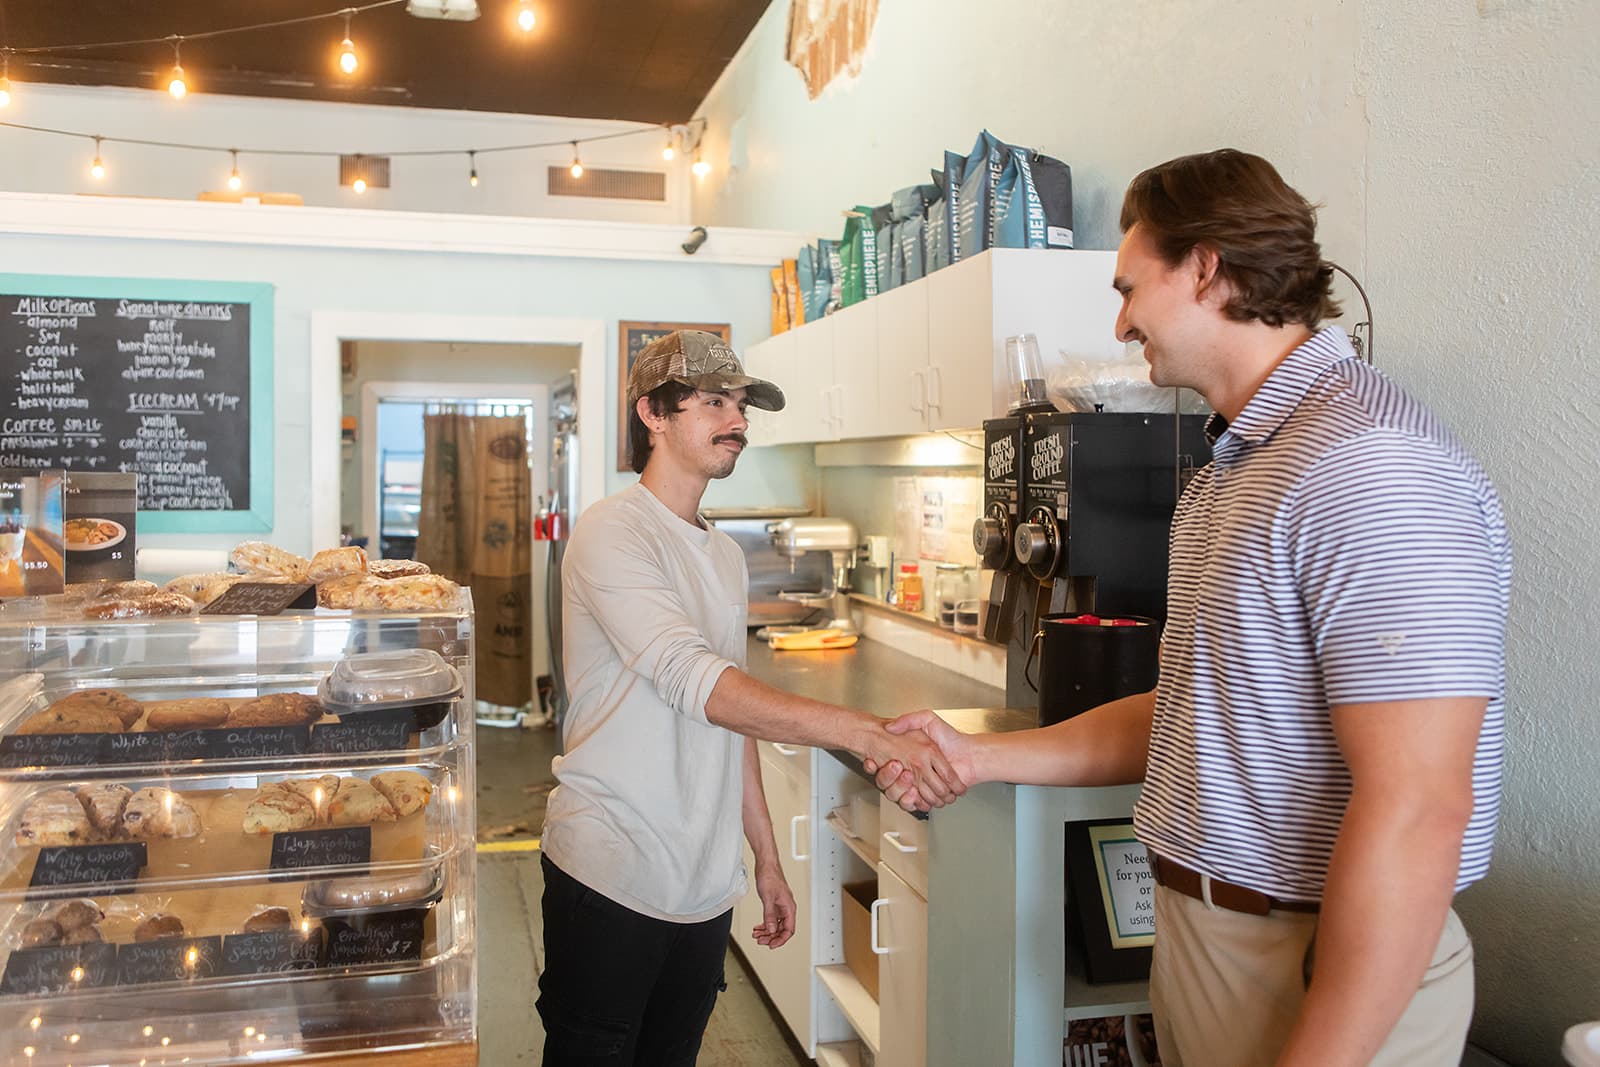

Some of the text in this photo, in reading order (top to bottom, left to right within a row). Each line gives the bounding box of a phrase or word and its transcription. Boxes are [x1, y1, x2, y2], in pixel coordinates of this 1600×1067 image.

[1015, 147, 1044, 239] HEMISPHERE
[863, 229, 878, 297] EMISPHERE
[1034, 432, 1060, 455] FRESH
[1032, 461, 1062, 480] COFFEE
[24, 561, 48, 569] $5.50
[1116, 868, 1132, 881] for
[1139, 887, 1151, 895] or
[1135, 900, 1152, 911] Ask
[1129, 914, 1155, 926] using
